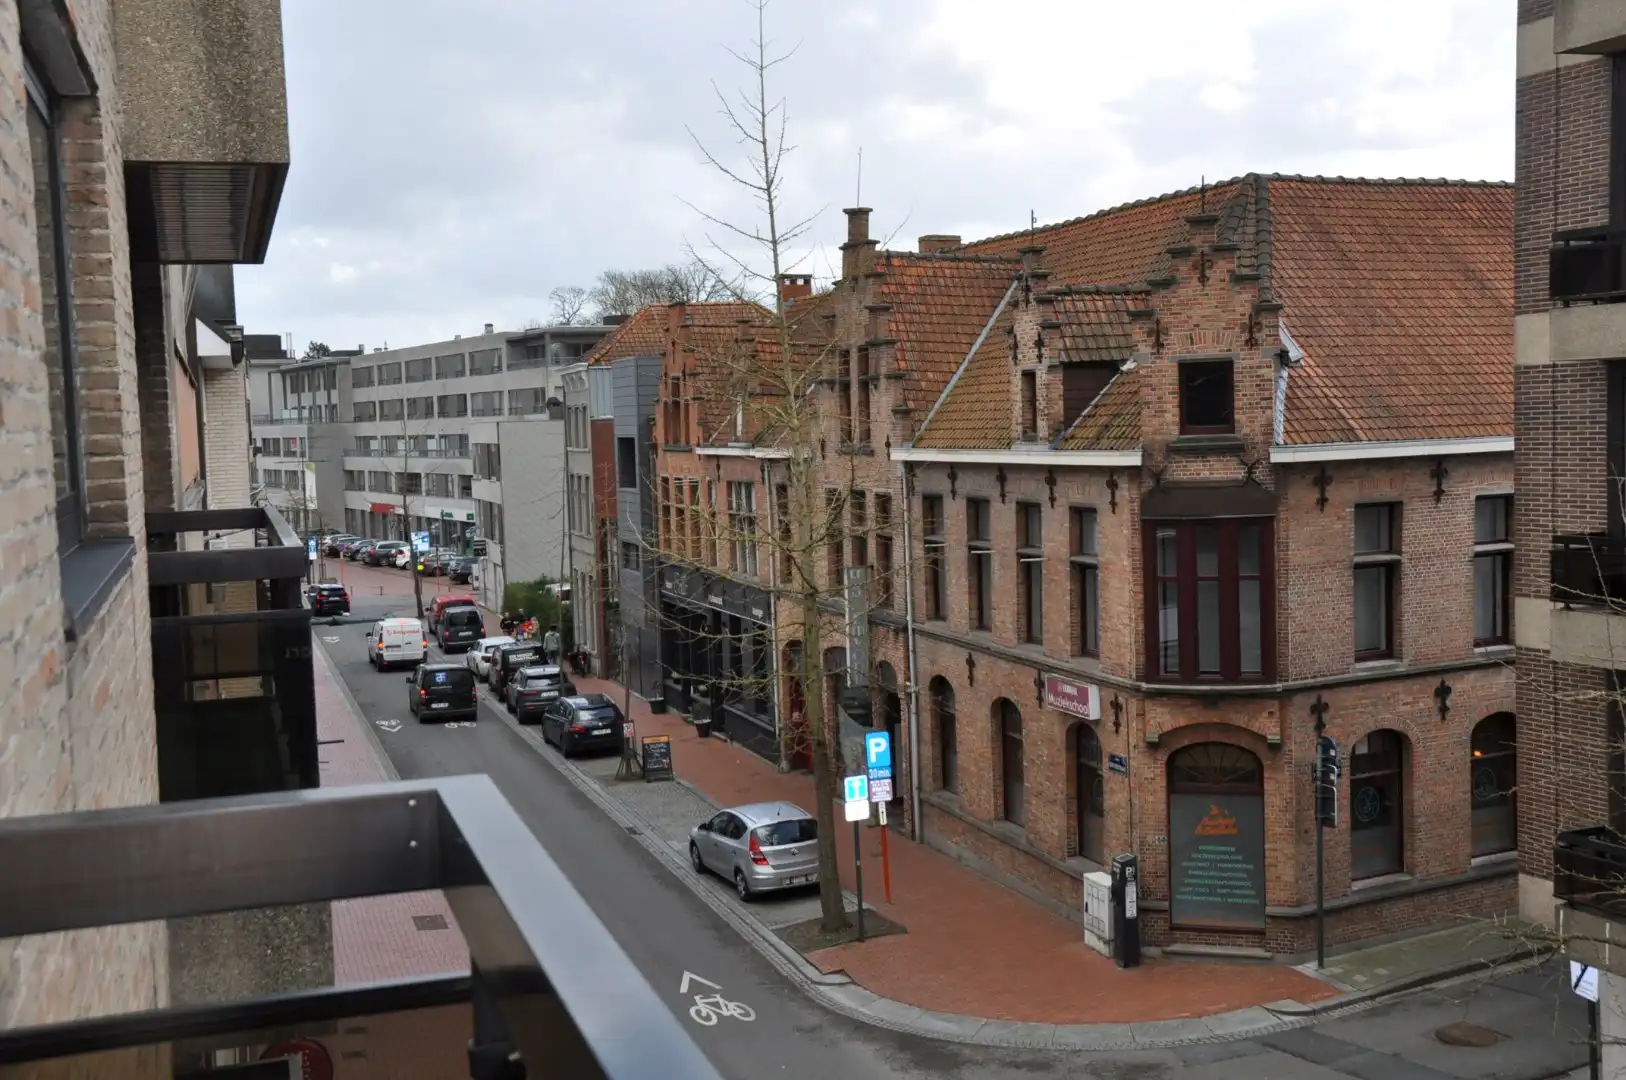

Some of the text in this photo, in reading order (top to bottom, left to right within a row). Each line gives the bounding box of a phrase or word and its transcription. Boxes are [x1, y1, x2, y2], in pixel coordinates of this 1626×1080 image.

[1048, 692, 1089, 714] Muziekschool
[869, 737, 887, 763] P
[869, 768, 878, 779] 30
